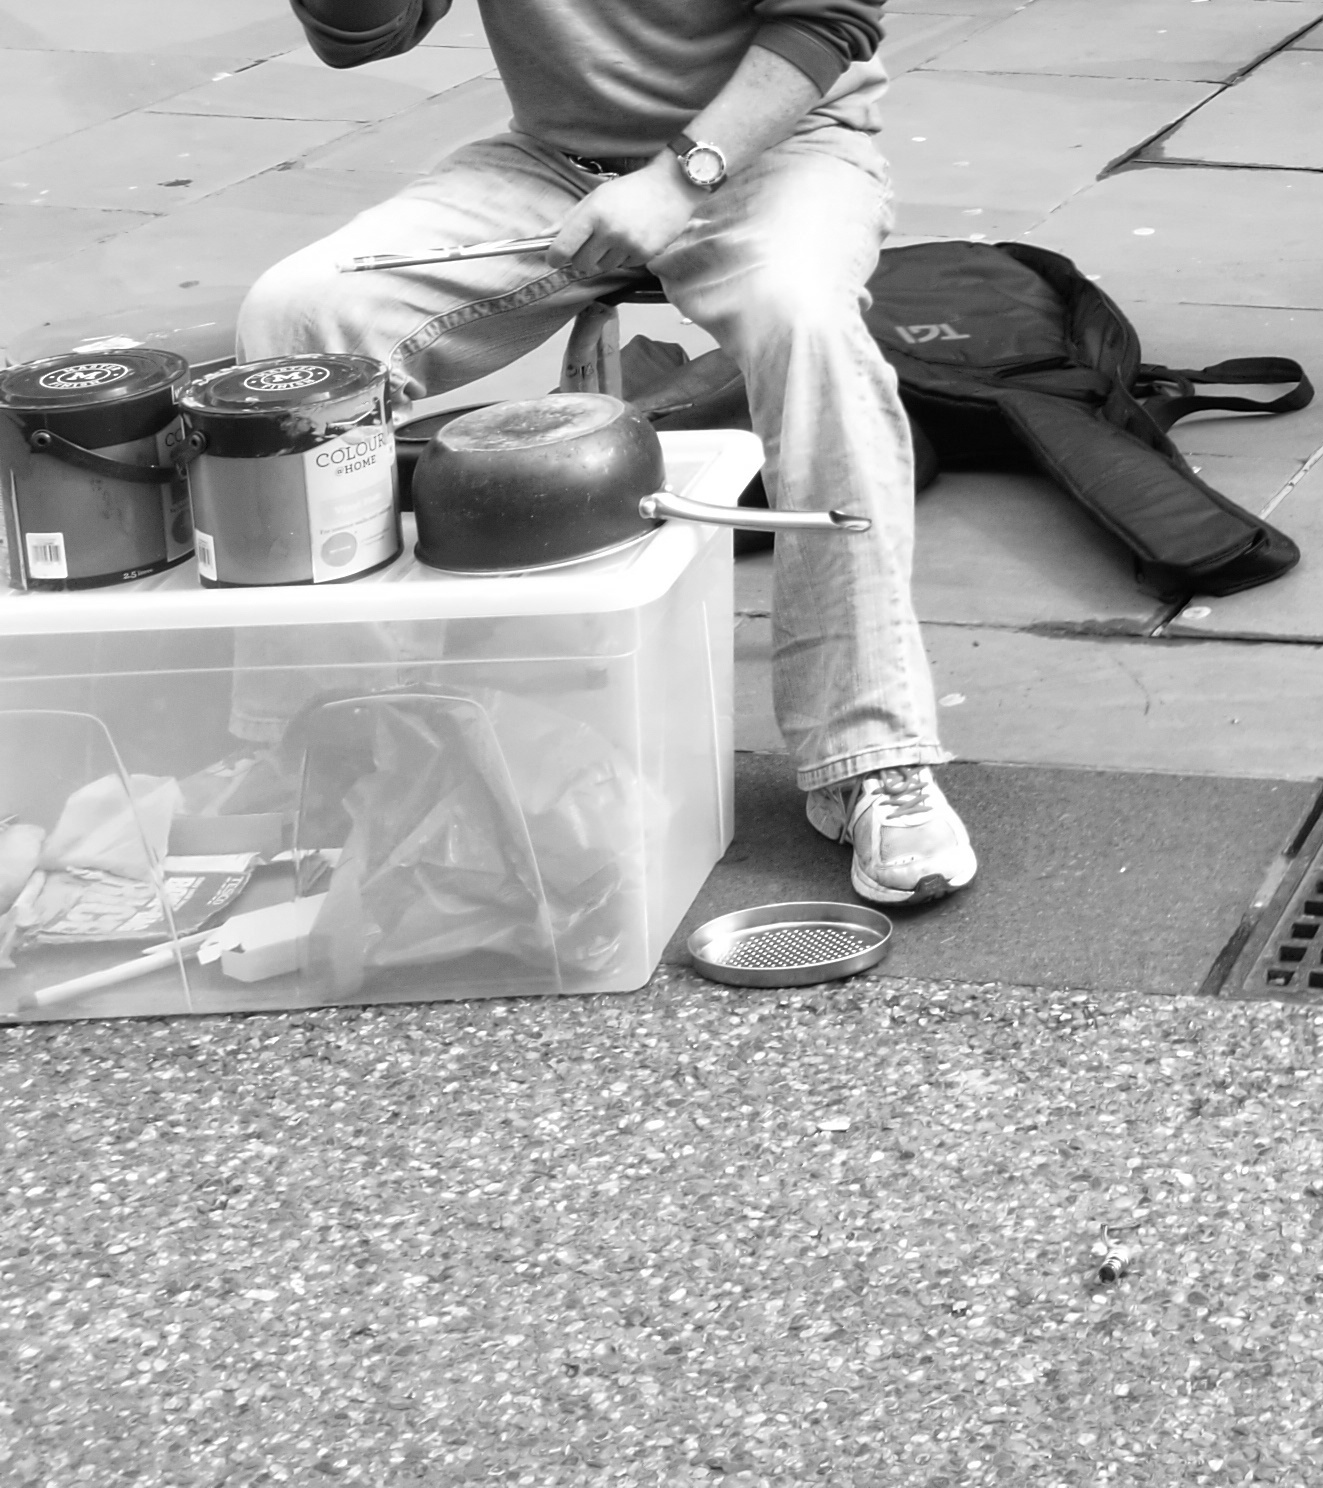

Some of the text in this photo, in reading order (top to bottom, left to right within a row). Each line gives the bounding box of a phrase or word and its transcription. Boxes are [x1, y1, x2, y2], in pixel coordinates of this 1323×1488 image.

[66, 371, 102, 381] M
[272, 372, 301, 382] M
[315, 432, 387, 468] COLOUR
[336, 454, 377, 475] @HOME
[212, 876, 245, 905] TESCO
